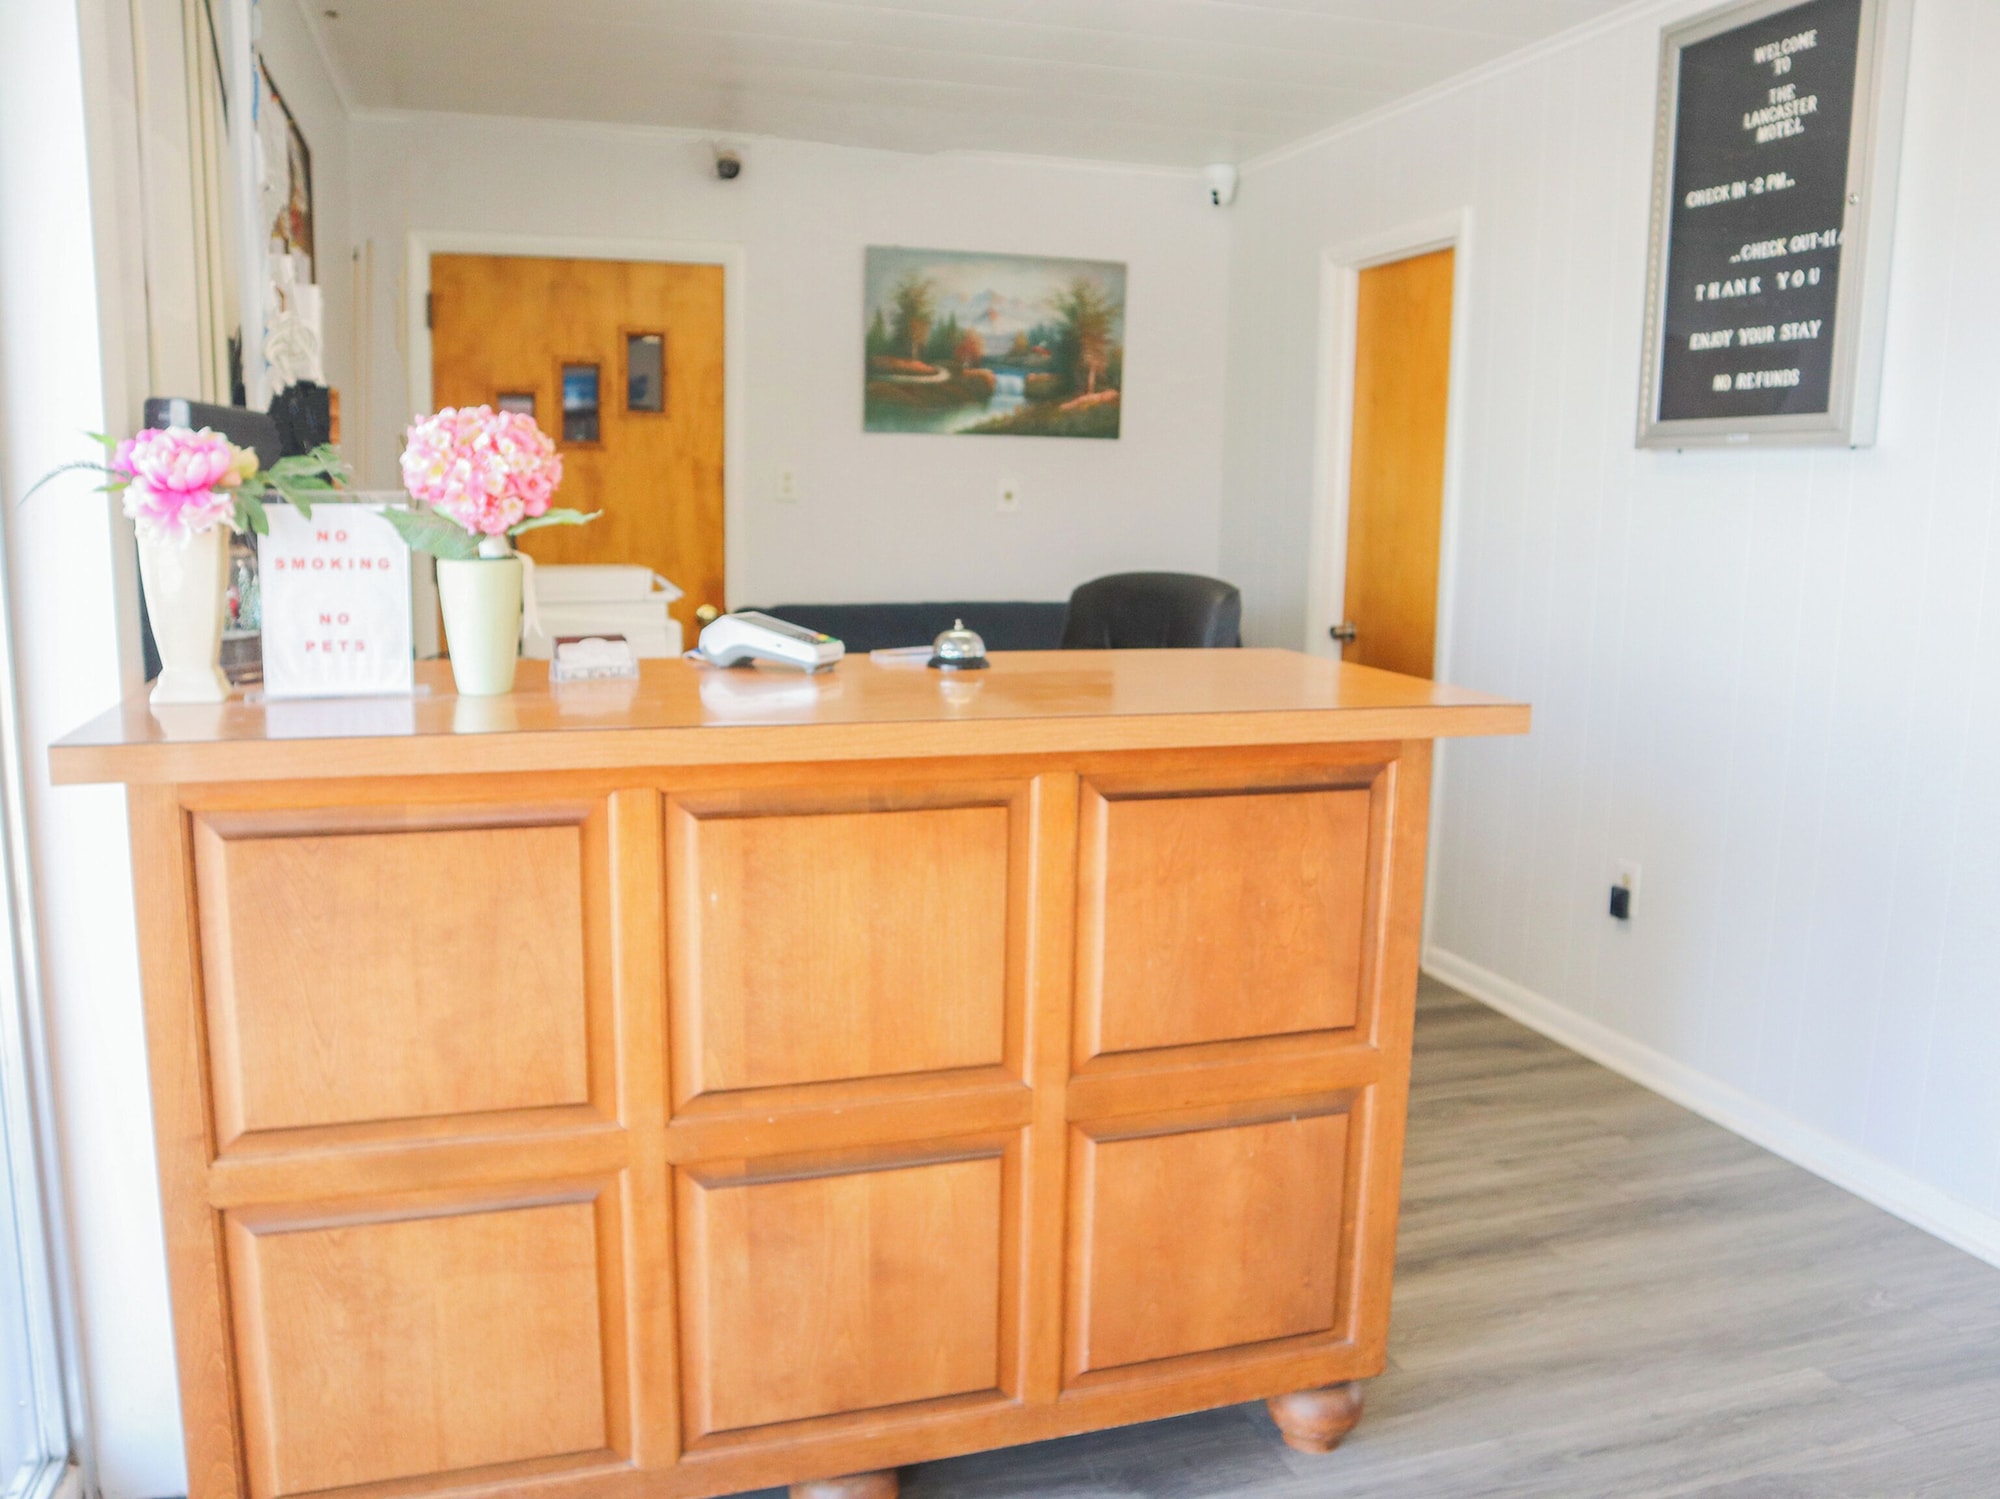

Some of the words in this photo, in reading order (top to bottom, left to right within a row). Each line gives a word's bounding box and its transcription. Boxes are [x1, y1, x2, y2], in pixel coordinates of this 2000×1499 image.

[1753, 29, 1818, 63] WELCOME
[1773, 56, 1792, 75] TO
[1769, 83, 1796, 104] THE
[1743, 95, 1818, 129] LANCASTER
[1685, 184, 1731, 208] CHECK
[1731, 180, 1747, 199] IN
[1695, 276, 1761, 301] THANK
[1776, 267, 1821, 290] YOU
[1689, 329, 1734, 351] ENJOY
[1738, 325, 1776, 346] YOUR
[1779, 319, 1822, 341] STAY
[1712, 373, 1732, 391] NO
[1735, 368, 1800, 390] REFUNDS
[316, 530, 348, 542] NO
[274, 557, 391, 570] SMOKING
[319, 613, 350, 625] NO
[304, 640, 366, 652] PETS
